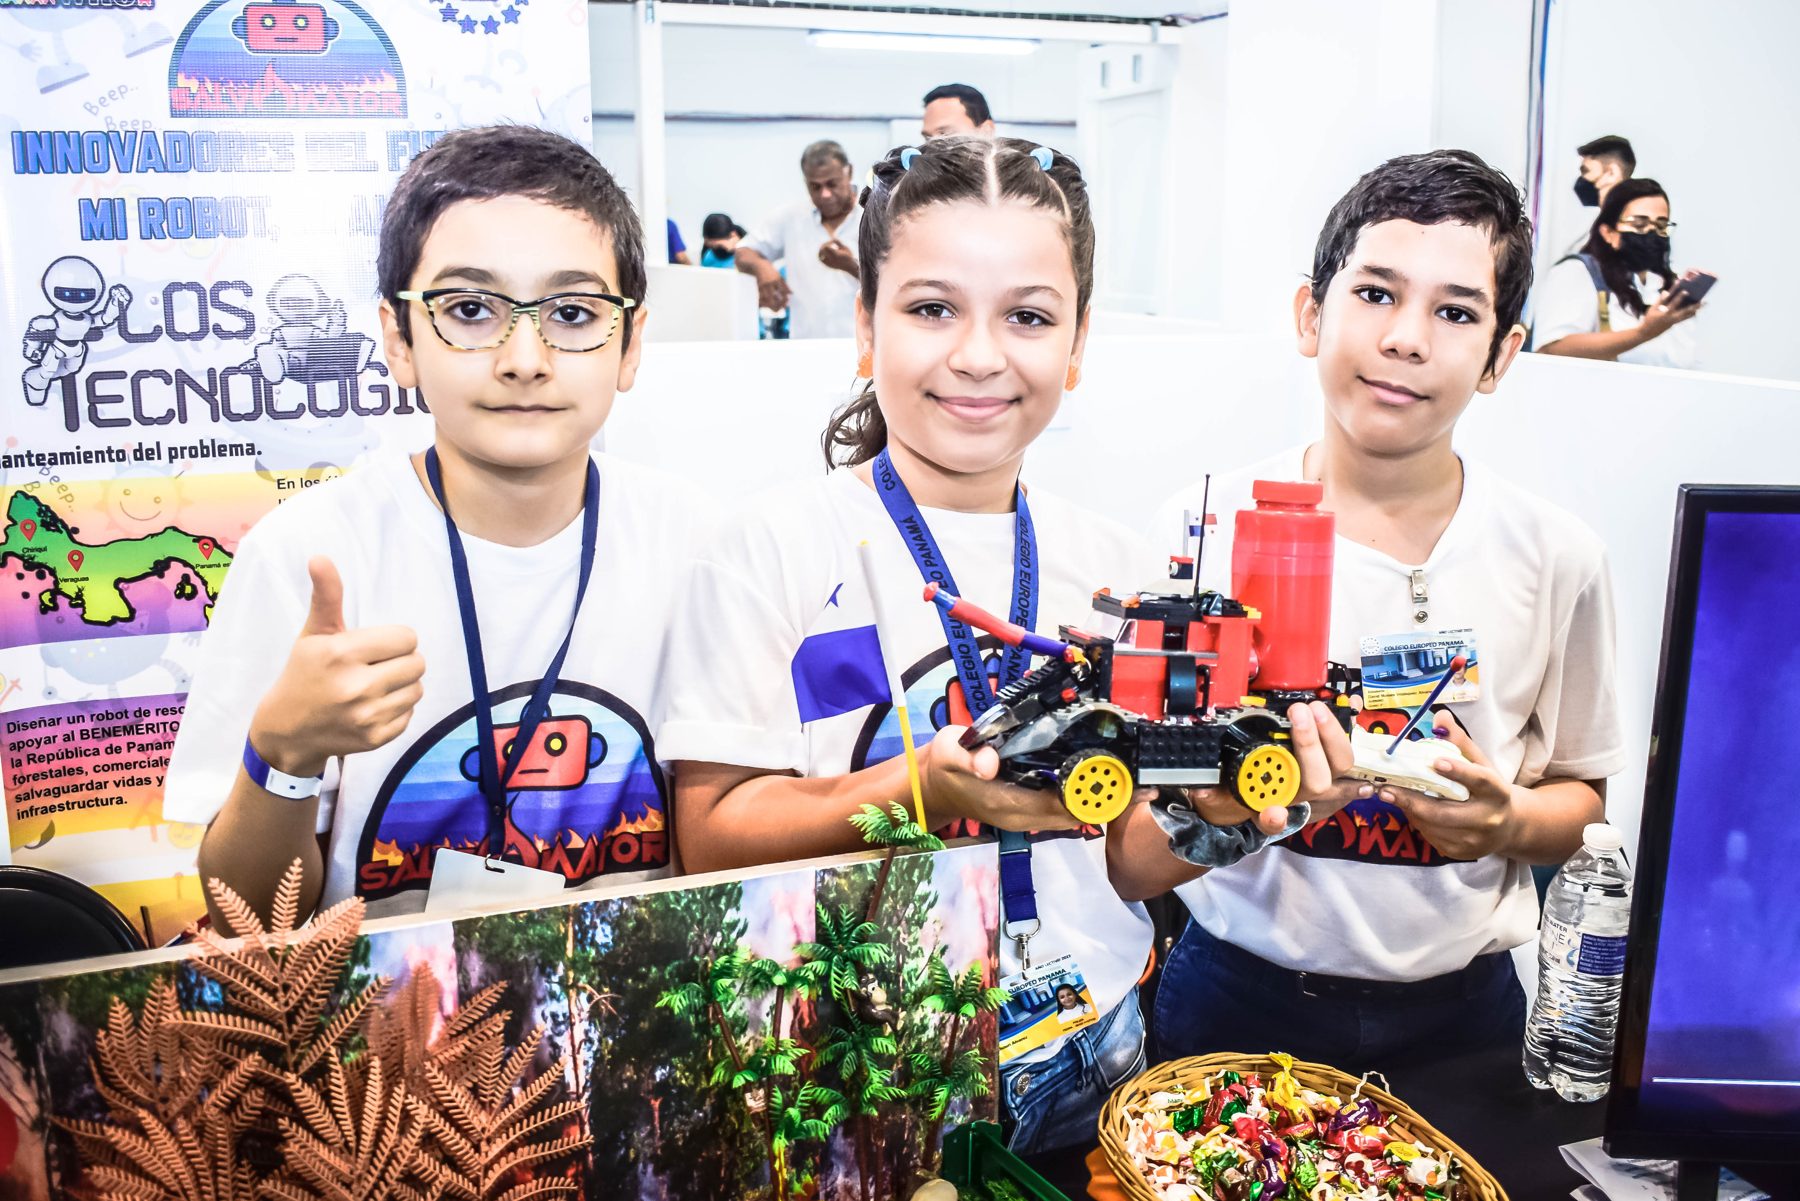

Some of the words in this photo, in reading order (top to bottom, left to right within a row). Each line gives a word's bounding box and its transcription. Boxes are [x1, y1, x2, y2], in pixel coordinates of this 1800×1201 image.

[11, 130, 295, 174] INNOVADORES
[79, 198, 128, 241] MI
[117, 280, 256, 344] LOS
[23, 327, 431, 433] TECNOLOGI
[134, 441, 162, 461] del
[168, 439, 262, 464] problema.
[277, 478, 295, 490] En
[900, 515, 938, 567] PANAMA
[1019, 515, 1031, 568] COLEGIO
[59, 576, 89, 584] Veraguas
[1015, 571, 1031, 629] EUROPE
[957, 643, 990, 711] COLEGIO
[6, 716, 62, 734] Diseñar
[67, 714, 85, 725] un
[90, 708, 129, 722] robot
[133, 706, 151, 719] de
[8, 733, 58, 752] apoyar
[62, 730, 75, 743] al
[80, 721, 180, 740] BENEMERITO
[10, 757, 22, 769] la
[27, 746, 100, 765] República
[104, 743, 122, 756] de
[12, 766, 89, 786] forestales,
[15, 779, 109, 804] salvaguardar
[113, 775, 152, 788] vidas
[156, 775, 165, 787] y
[17, 796, 128, 821] infraestructura.
[1039, 968, 1067, 982] PANAMA
